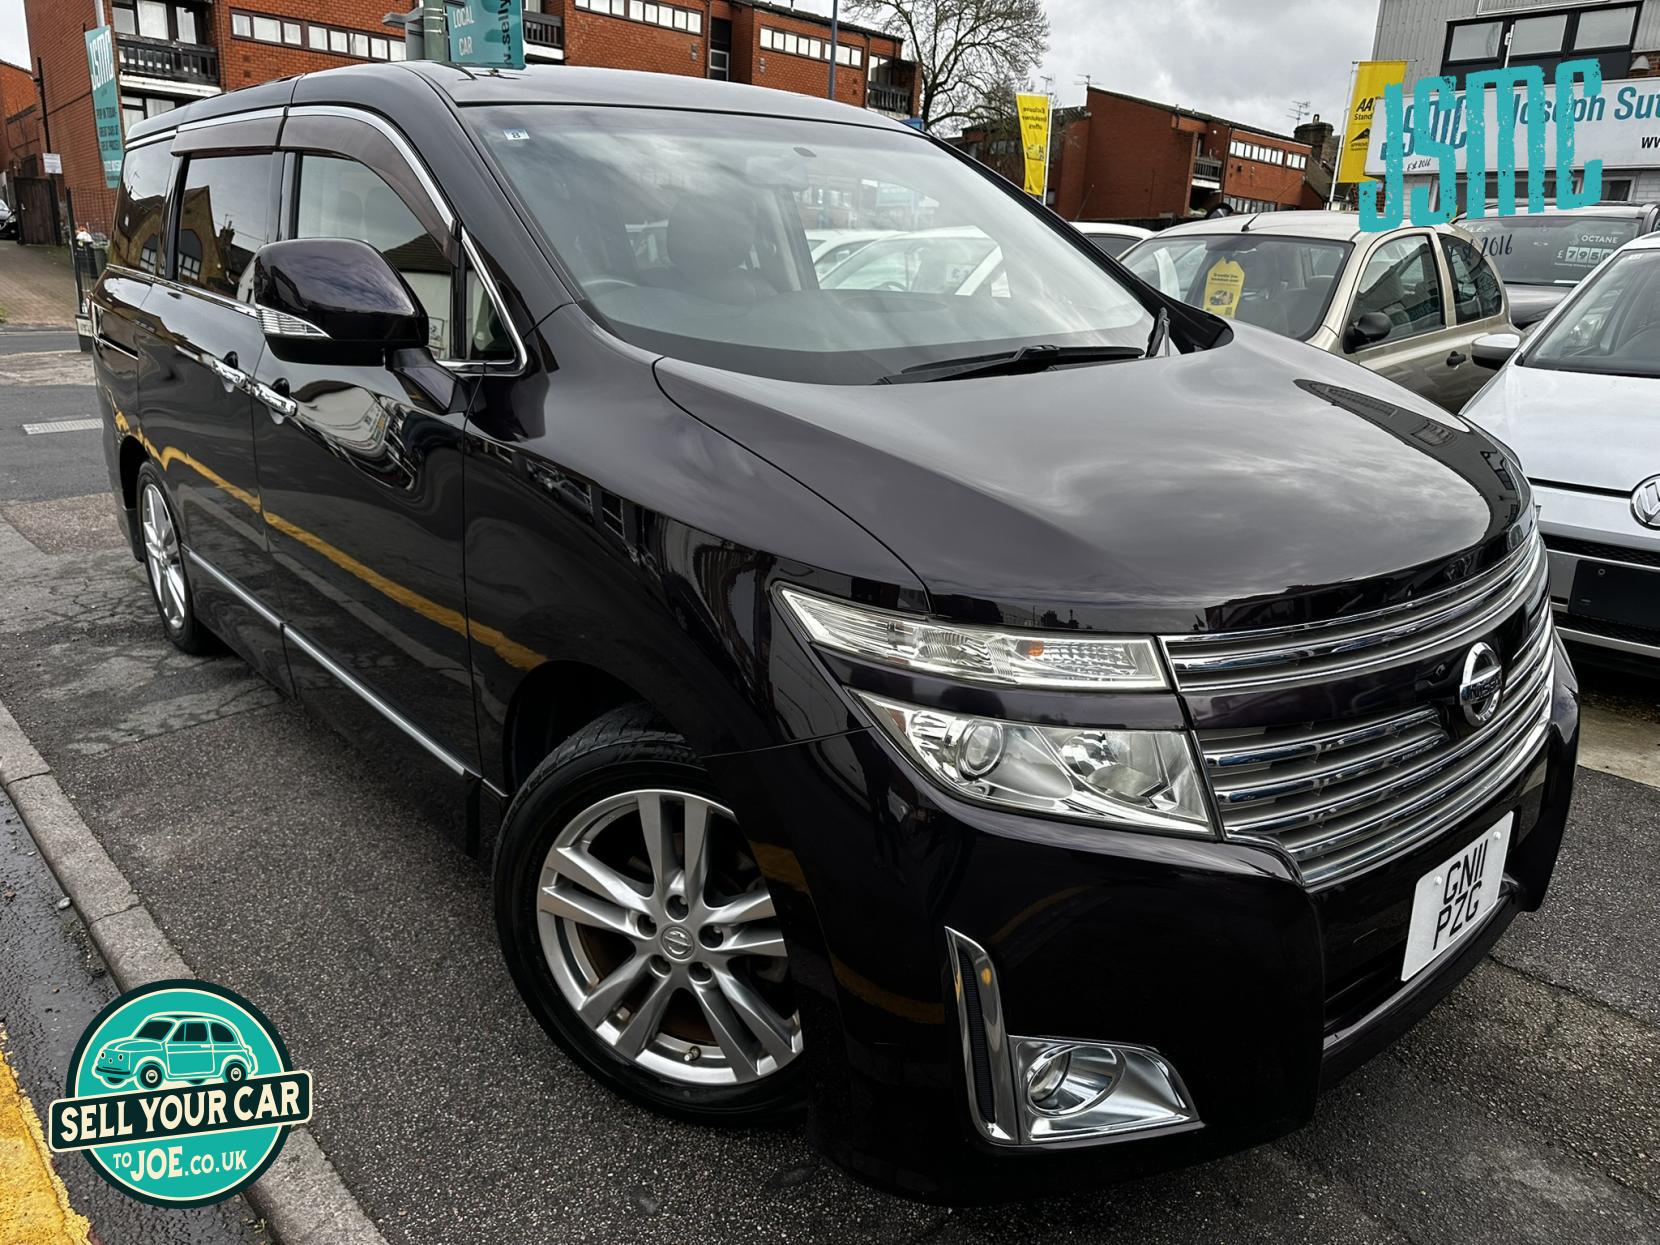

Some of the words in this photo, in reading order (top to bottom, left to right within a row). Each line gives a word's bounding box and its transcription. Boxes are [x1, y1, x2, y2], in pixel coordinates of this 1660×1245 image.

[453, 6, 474, 28] LOCAL
[458, 36, 473, 56] CAR
[1356, 98, 1374, 113] AA
[1581, 234, 1619, 245] OCTANE
[1443, 839, 1488, 905] GN11
[1433, 880, 1482, 950] PZG
